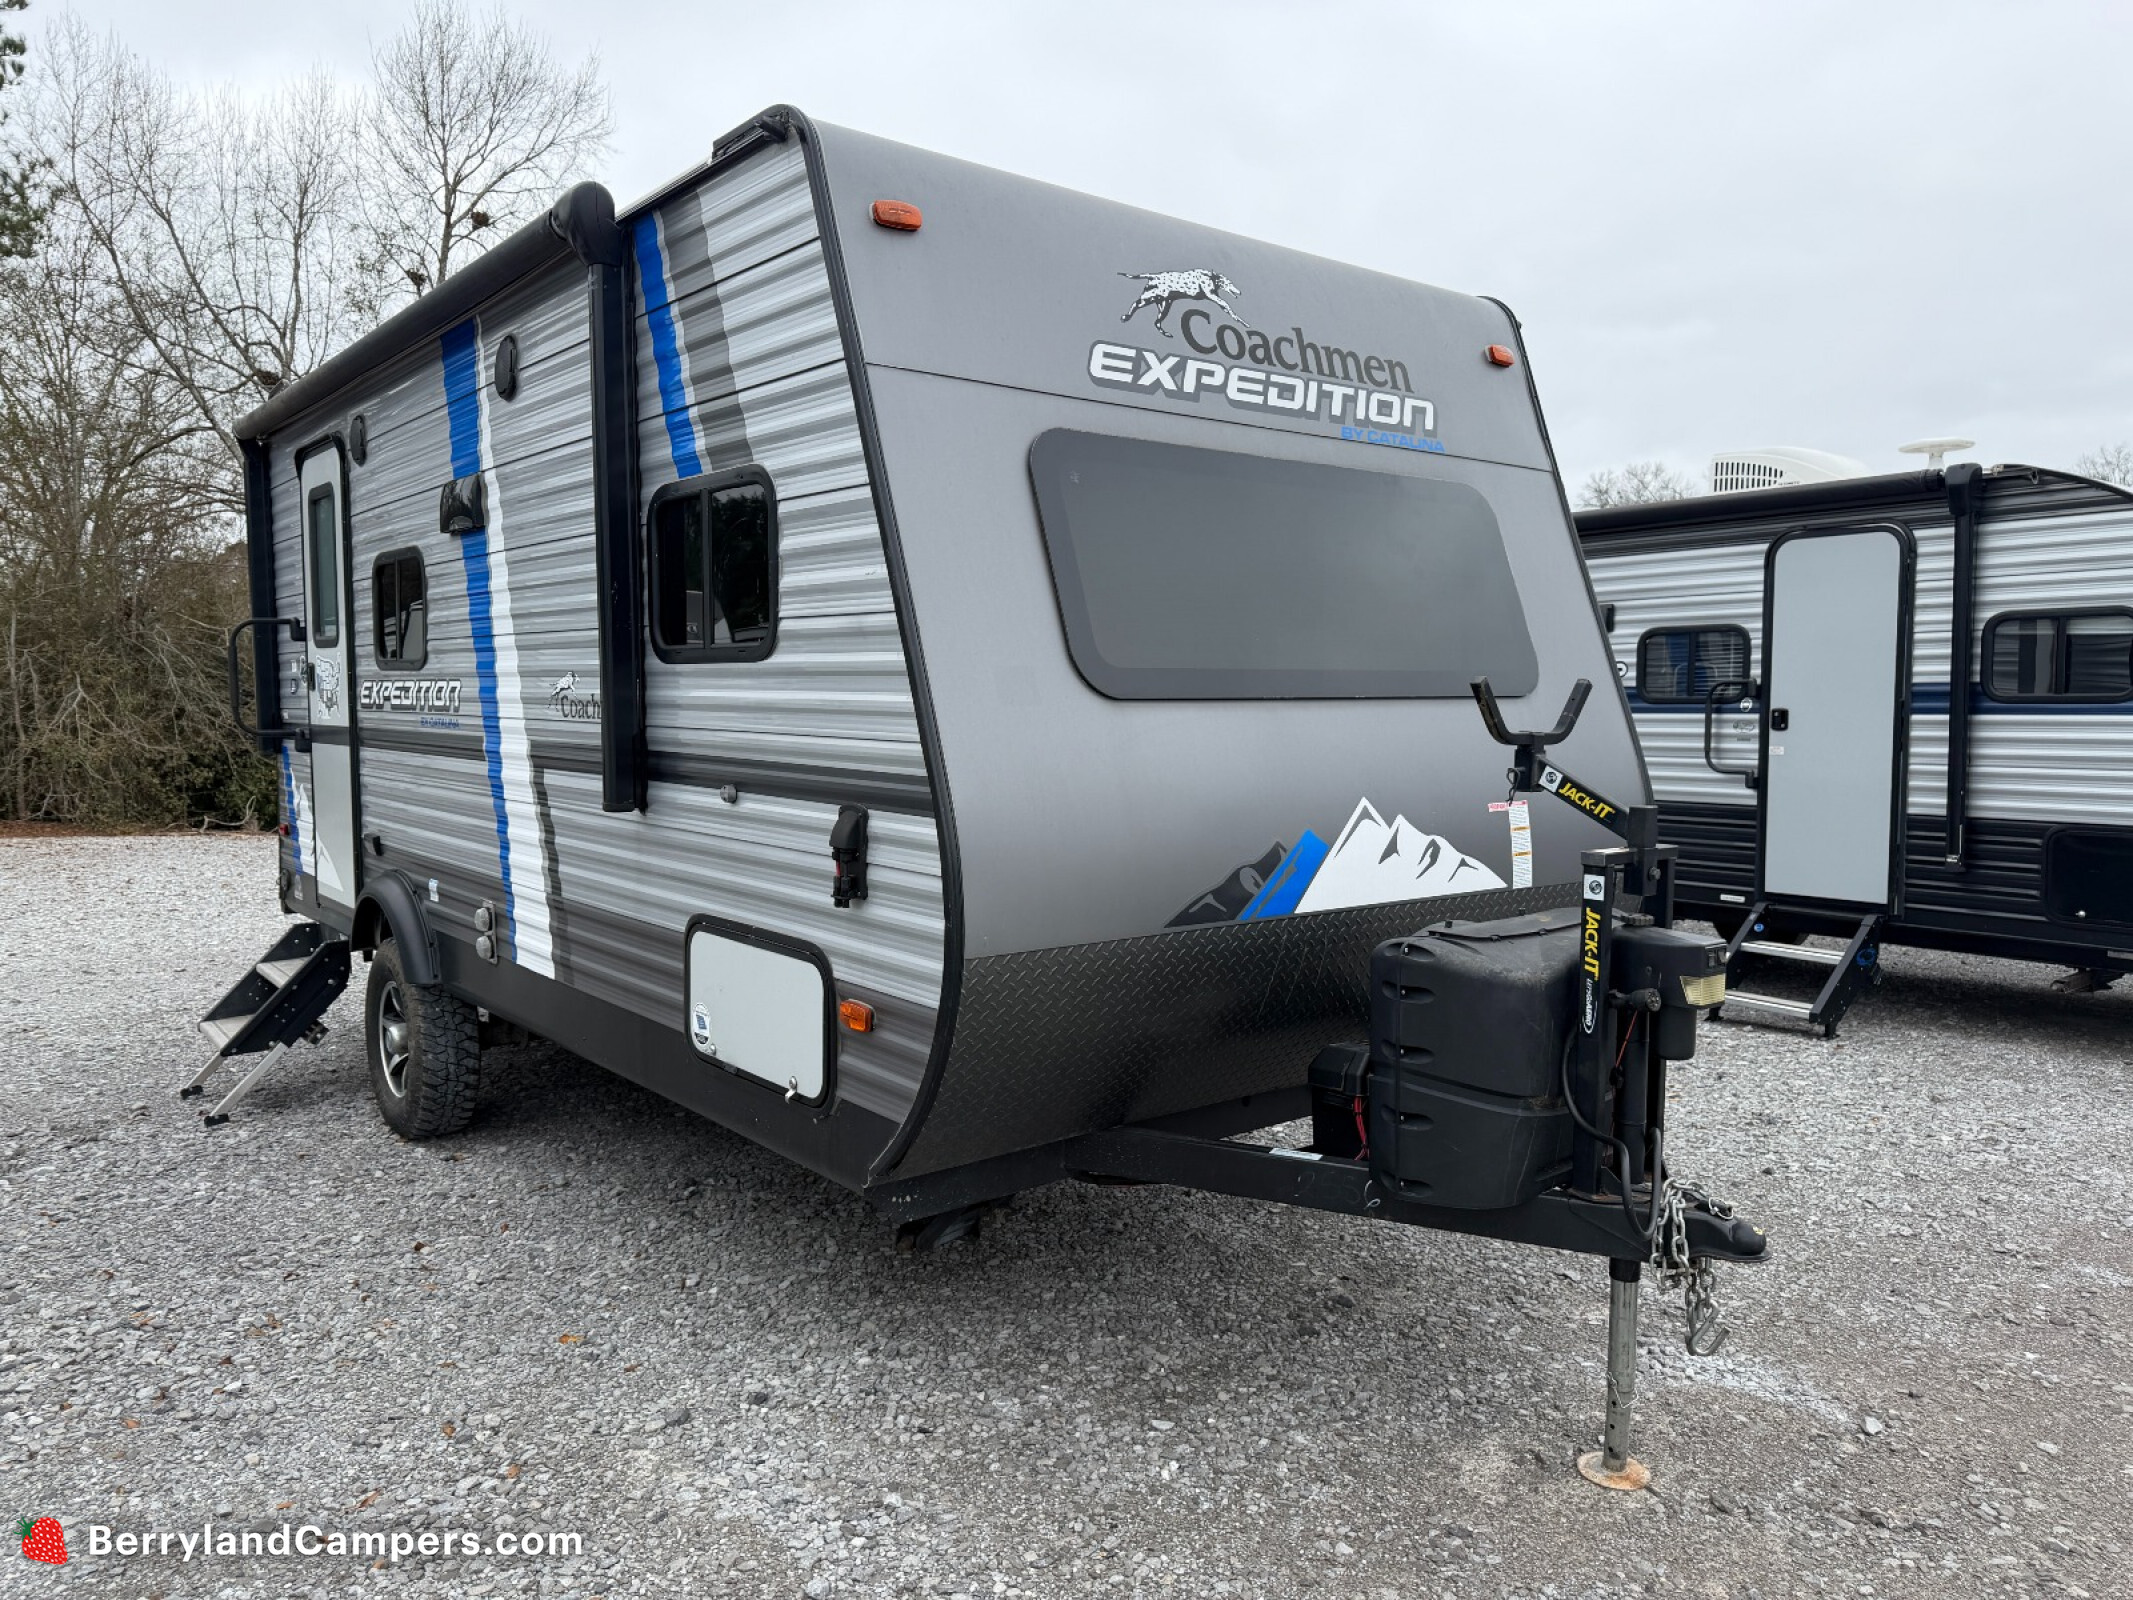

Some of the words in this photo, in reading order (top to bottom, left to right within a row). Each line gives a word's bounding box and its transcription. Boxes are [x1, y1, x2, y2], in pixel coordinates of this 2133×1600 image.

[1181, 308, 1414, 393] Coachmen
[1088, 341, 1437, 434] EXPEDITION
[1340, 425, 1366, 440] BY
[1367, 429, 1446, 452] CATALINA
[360, 679, 461, 710] EXPEDITION
[1558, 782, 1615, 818] JACK-IT
[1584, 907, 1601, 980] JACK-IT
